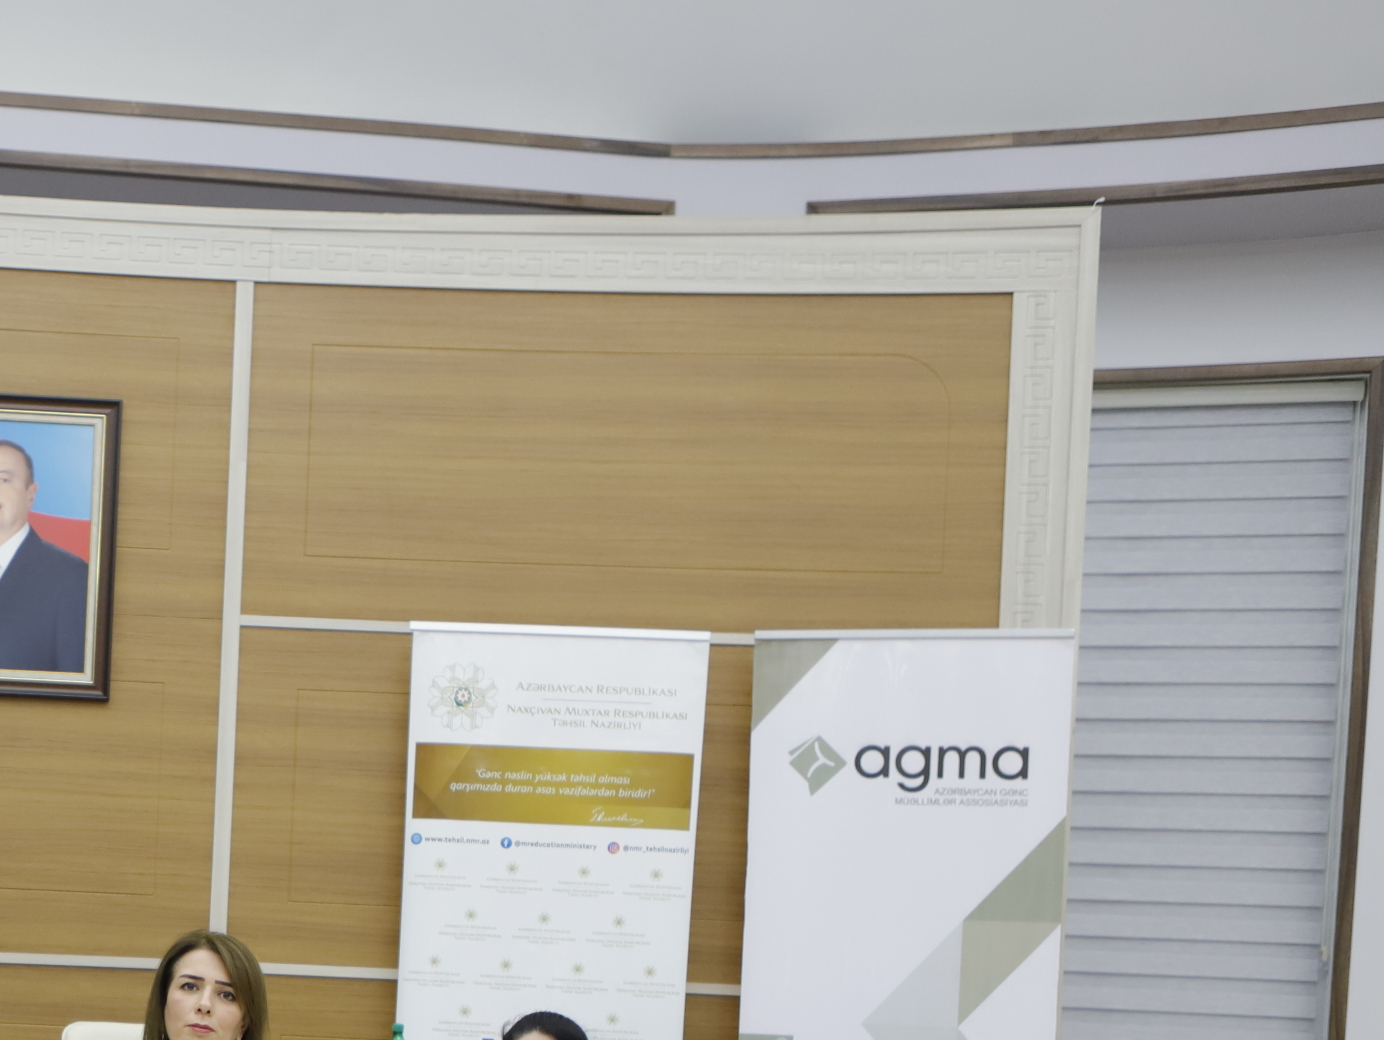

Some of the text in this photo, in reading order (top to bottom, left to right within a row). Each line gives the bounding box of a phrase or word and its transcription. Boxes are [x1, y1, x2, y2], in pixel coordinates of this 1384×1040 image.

[516, 682, 677, 698] AZƏRBAYCAN RESPUBLİKASI
[507, 704, 688, 721] NAXÇIVAN MUXTAR RESPUBLİKASI
[551, 718, 642, 731] TƏHSİL NAZİRLİYİ
[854, 744, 1030, 793] agma
[504, 770, 532, 781] nəslin
[534, 772, 567, 784] yüksək
[570, 773, 596, 784] təhsil
[598, 774, 630, 785] alması
[450, 782, 502, 793] qarşımızda
[505, 783, 533, 793] duran
[536, 786, 556, 795] əsas
[559, 786, 616, 798] vəzifələrdən
